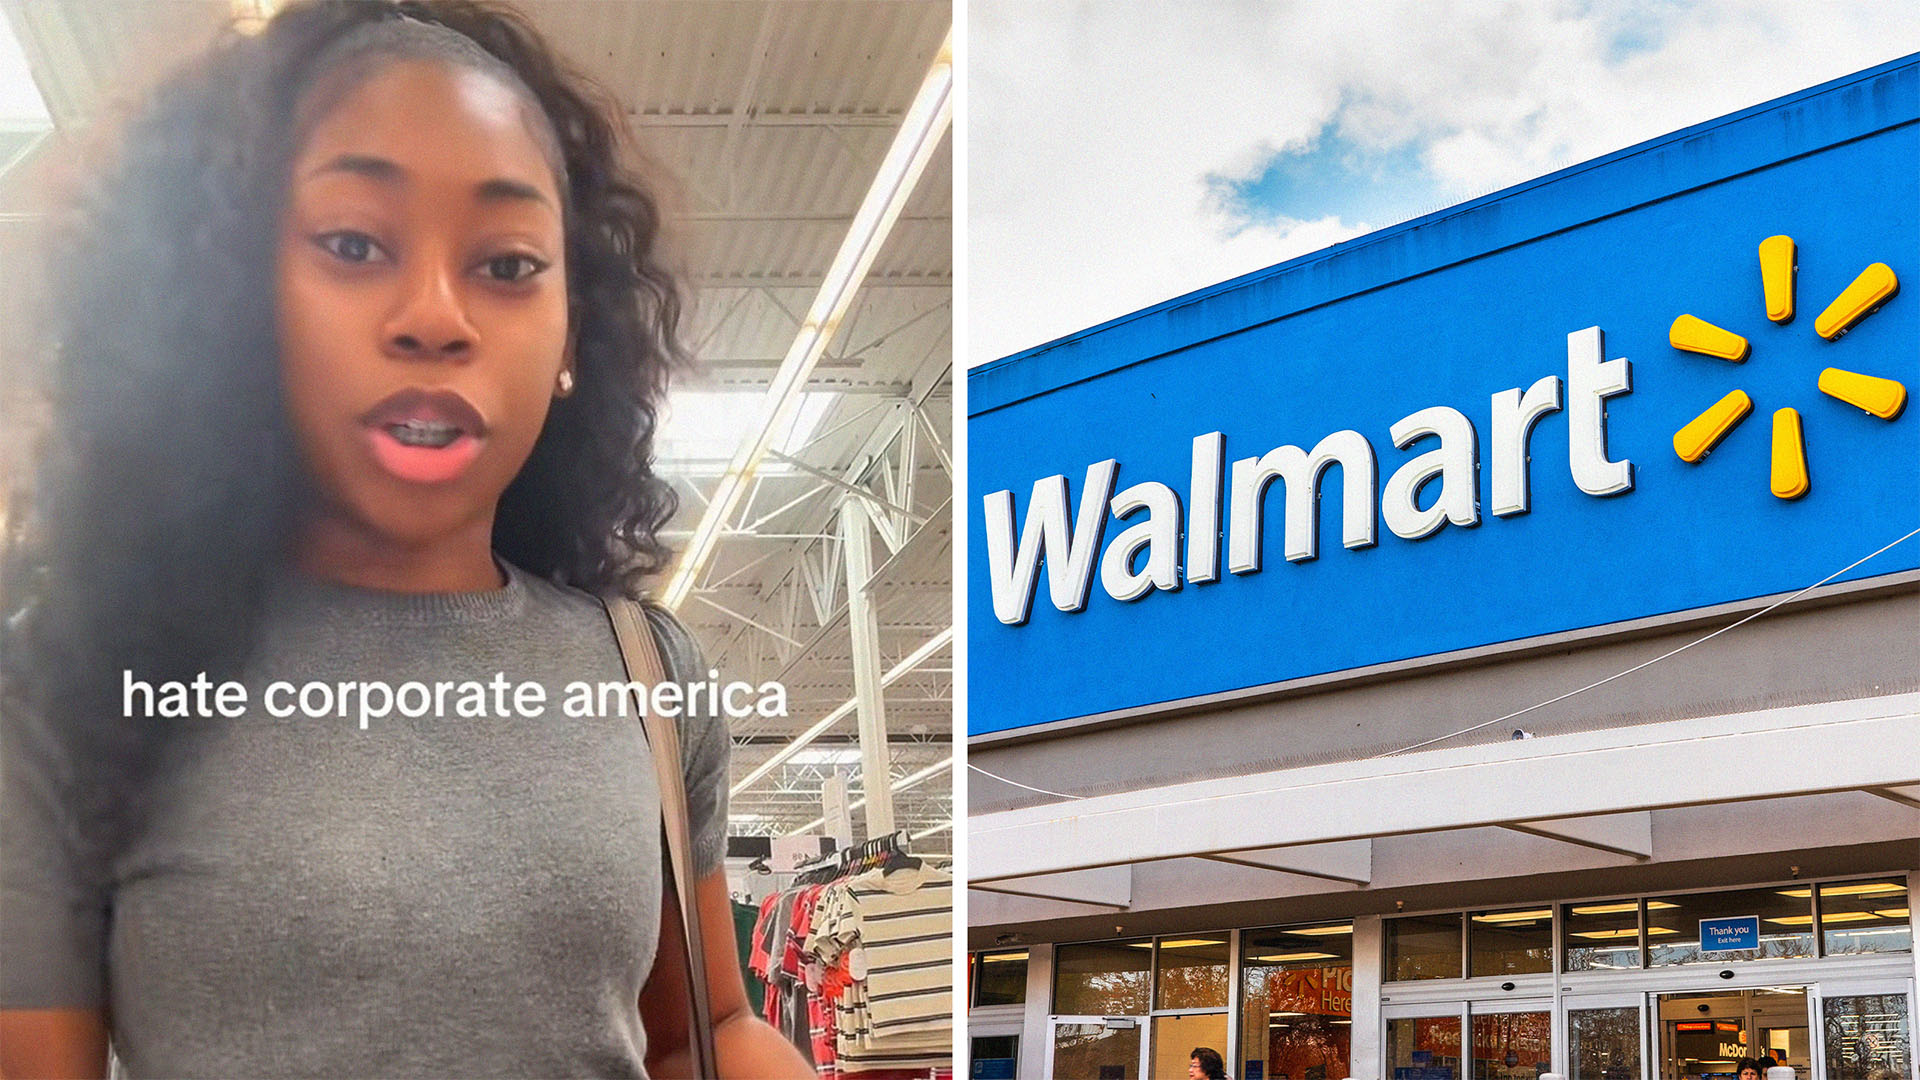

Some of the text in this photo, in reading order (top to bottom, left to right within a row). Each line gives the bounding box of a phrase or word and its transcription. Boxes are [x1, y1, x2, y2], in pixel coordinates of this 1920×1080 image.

[983, 325, 1632, 626] Walmart
[1709, 925, 1750, 936] Thank you
[1322, 990, 1352, 1012] Here
